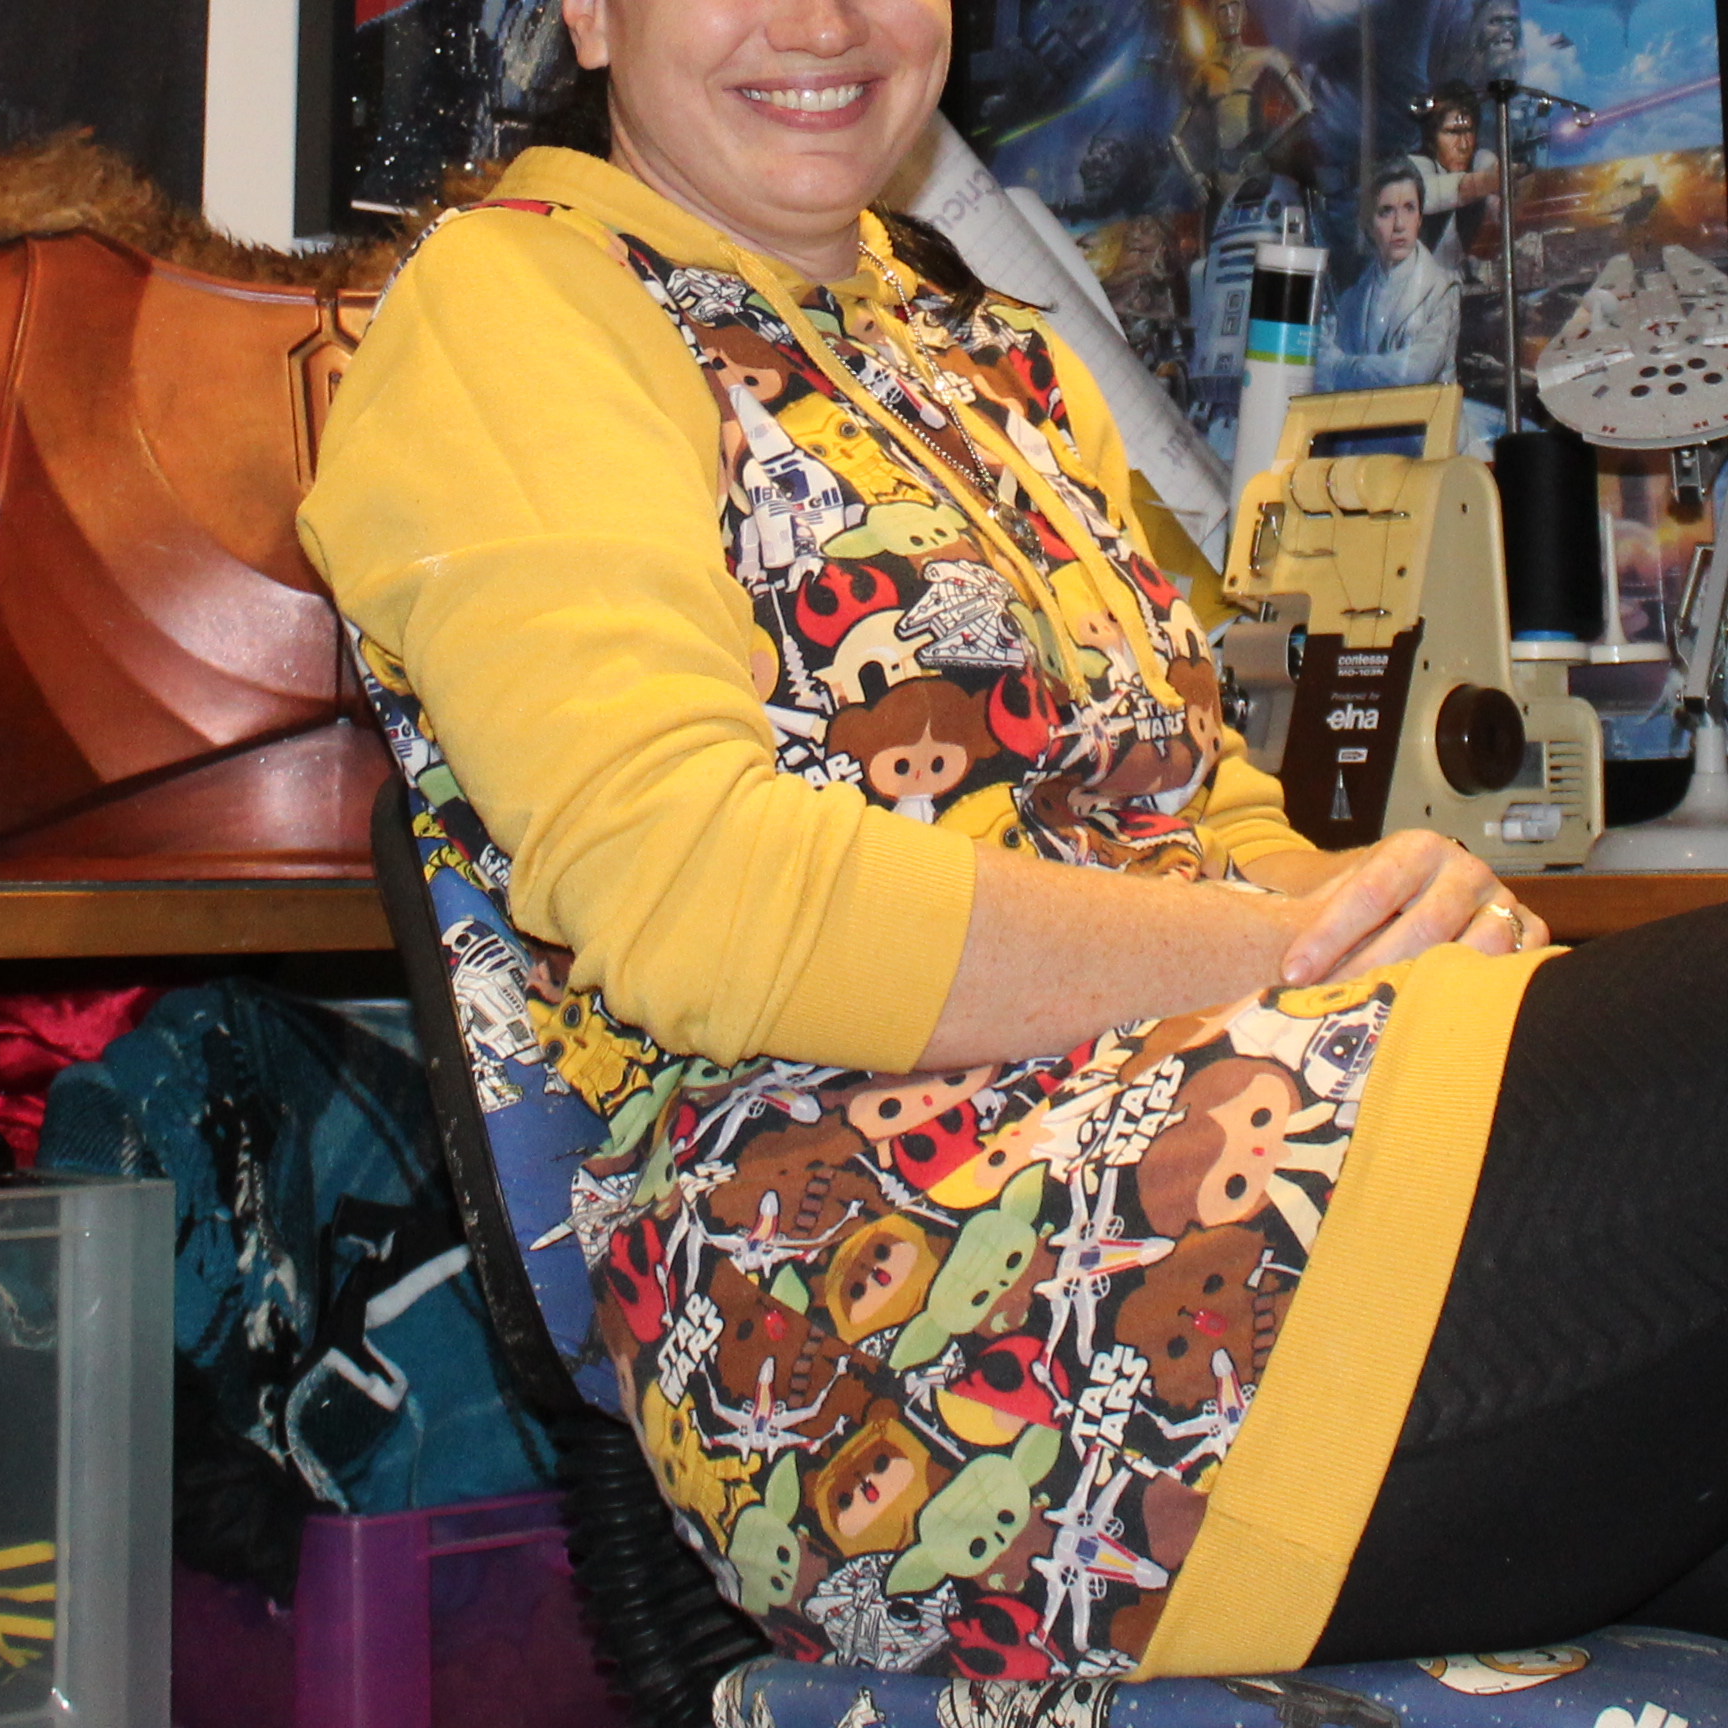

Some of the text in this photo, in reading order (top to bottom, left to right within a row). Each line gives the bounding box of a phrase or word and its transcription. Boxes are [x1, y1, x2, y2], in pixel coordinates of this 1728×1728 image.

[1135, 711, 1186, 742] WARS
[1326, 702, 1380, 731] elna
[657, 1292, 712, 1389] STAR
[663, 1303, 725, 1408] WARS
[1070, 1343, 1125, 1439] TAR
